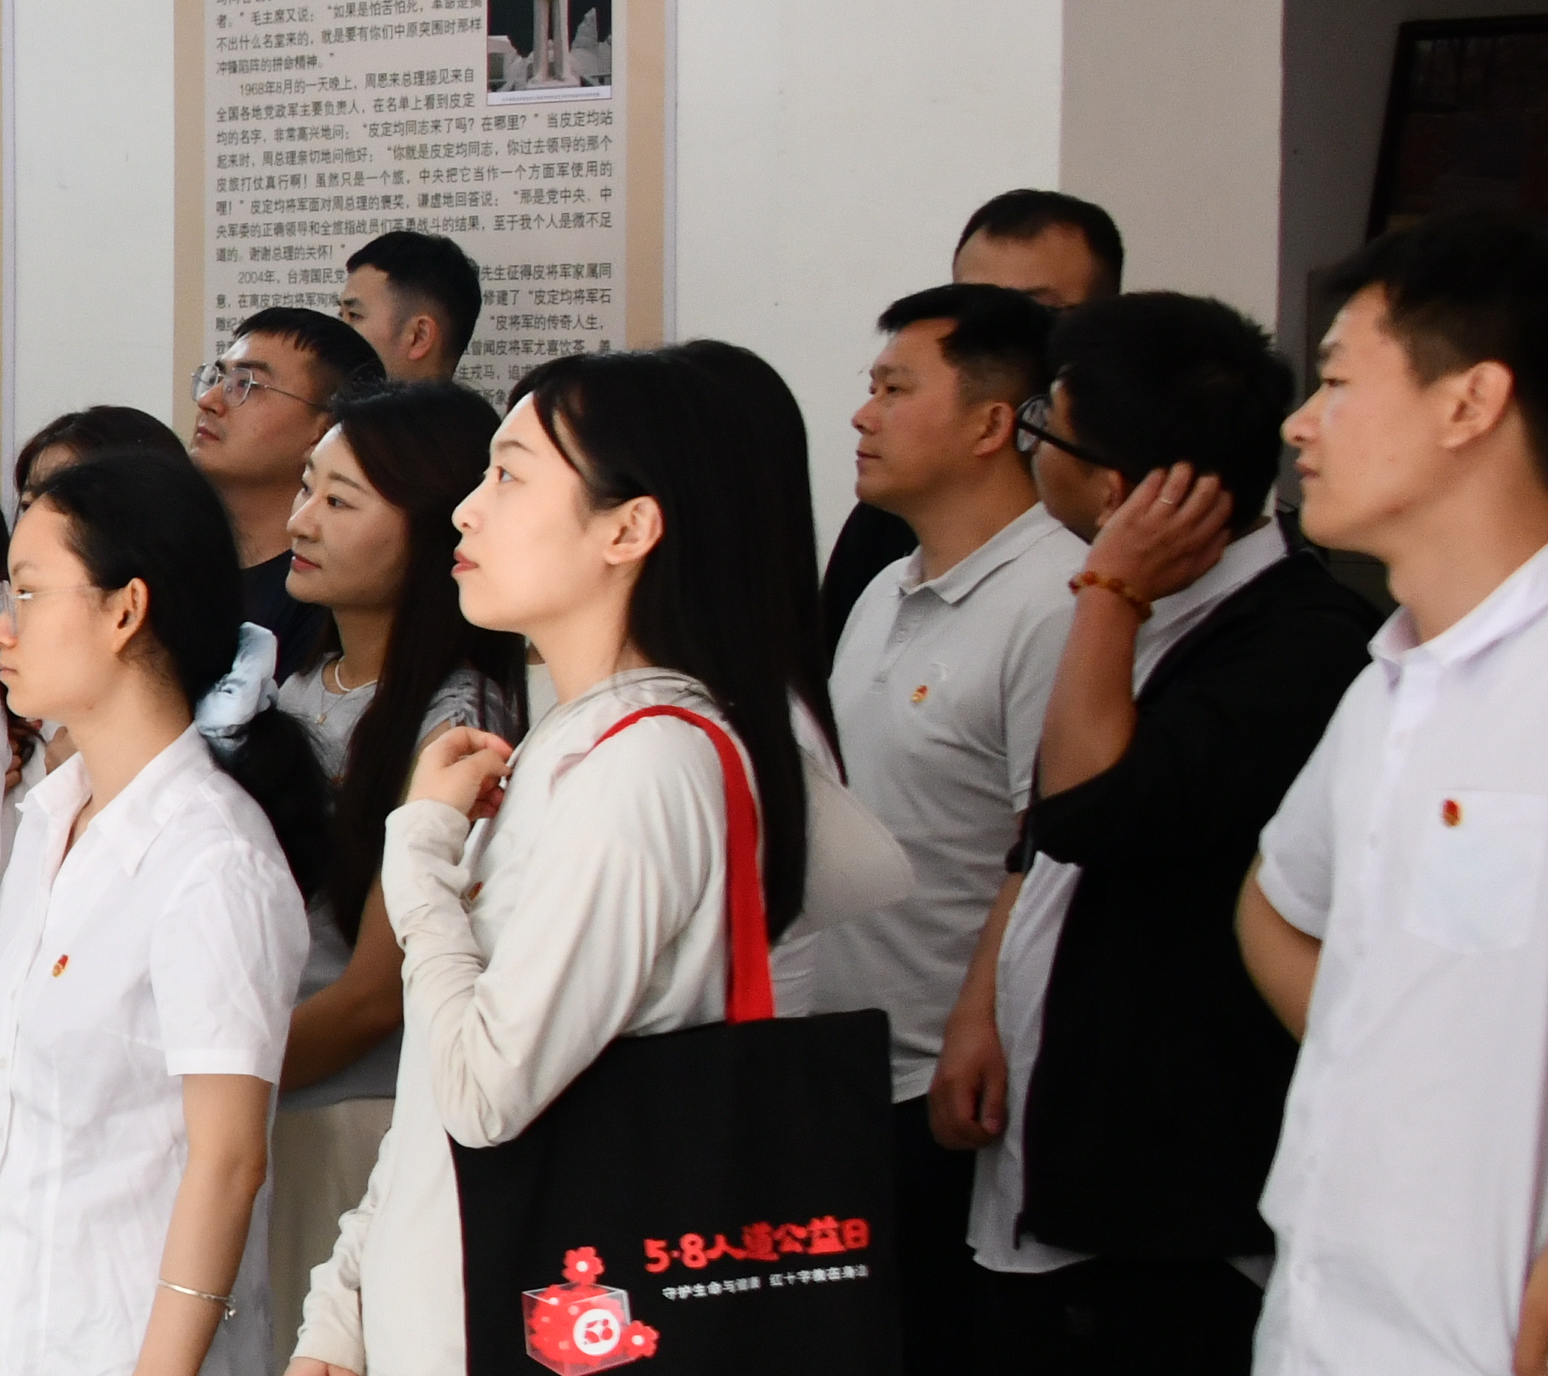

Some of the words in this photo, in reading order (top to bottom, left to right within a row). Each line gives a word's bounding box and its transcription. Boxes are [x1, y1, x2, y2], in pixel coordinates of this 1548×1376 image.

[478, 262, 611, 282] 先生征得皮将军家属同
